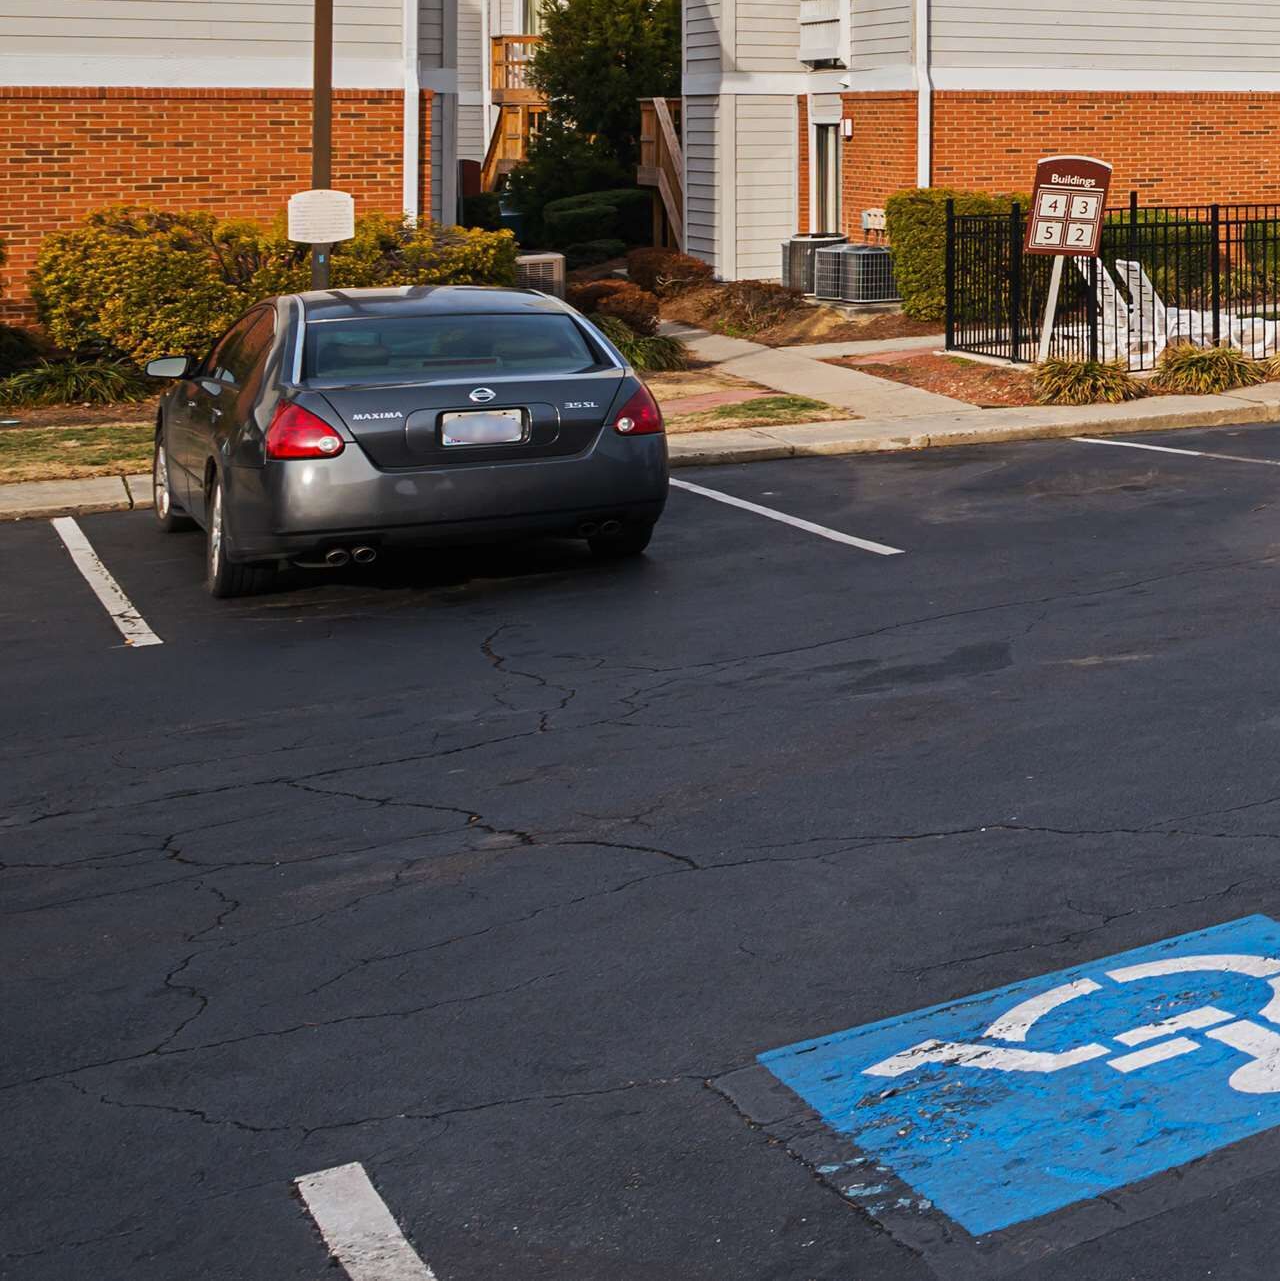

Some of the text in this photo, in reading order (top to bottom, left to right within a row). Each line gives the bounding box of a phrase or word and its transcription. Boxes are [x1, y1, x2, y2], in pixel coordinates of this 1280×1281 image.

[1051, 173, 1096, 188] Buildings
[1048, 199, 1089, 215] 4 3
[1043, 226, 1084, 242] 5 2
[352, 411, 403, 420] MAXIMA
